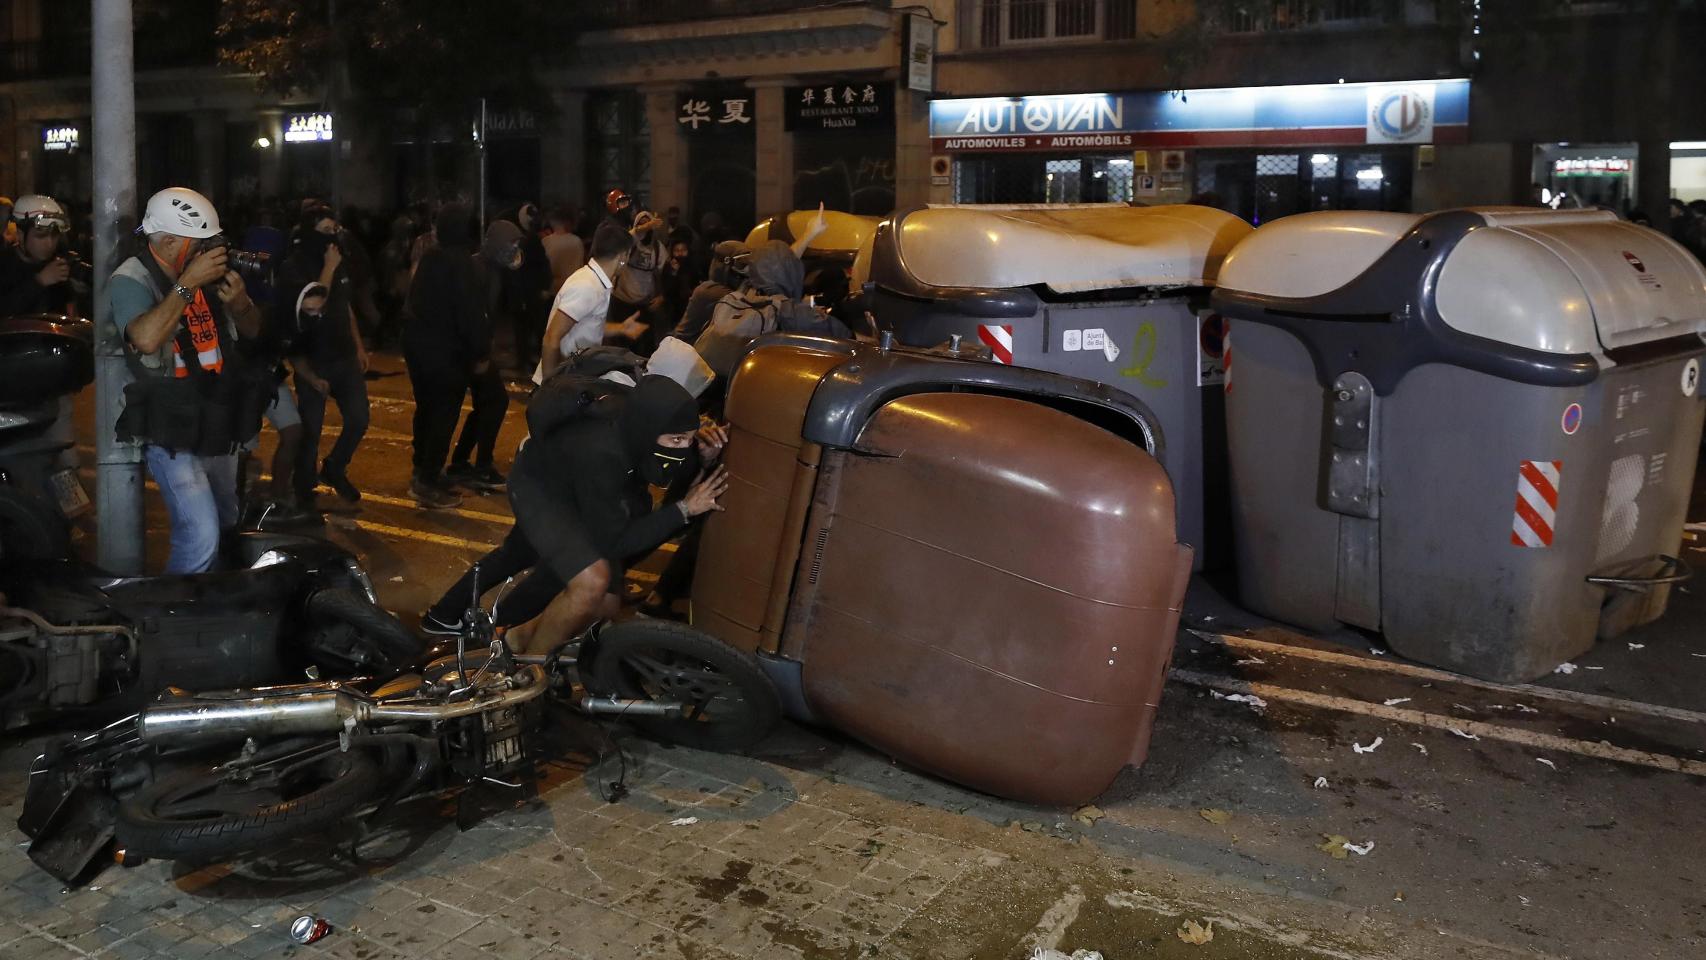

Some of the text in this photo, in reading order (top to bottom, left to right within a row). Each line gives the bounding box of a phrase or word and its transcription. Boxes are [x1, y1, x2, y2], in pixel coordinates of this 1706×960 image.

[678, 98, 752, 129] 华夏
[800, 105, 880, 117] RESTAURANT XINO
[955, 96, 1123, 133] AUTOVAN
[823, 117, 857, 128] HuaXia
[945, 134, 1132, 149] AUTOMOVILES AUTOMÒBILS
[1142, 176, 1152, 189] P
[1688, 367, 1697, 388] R
